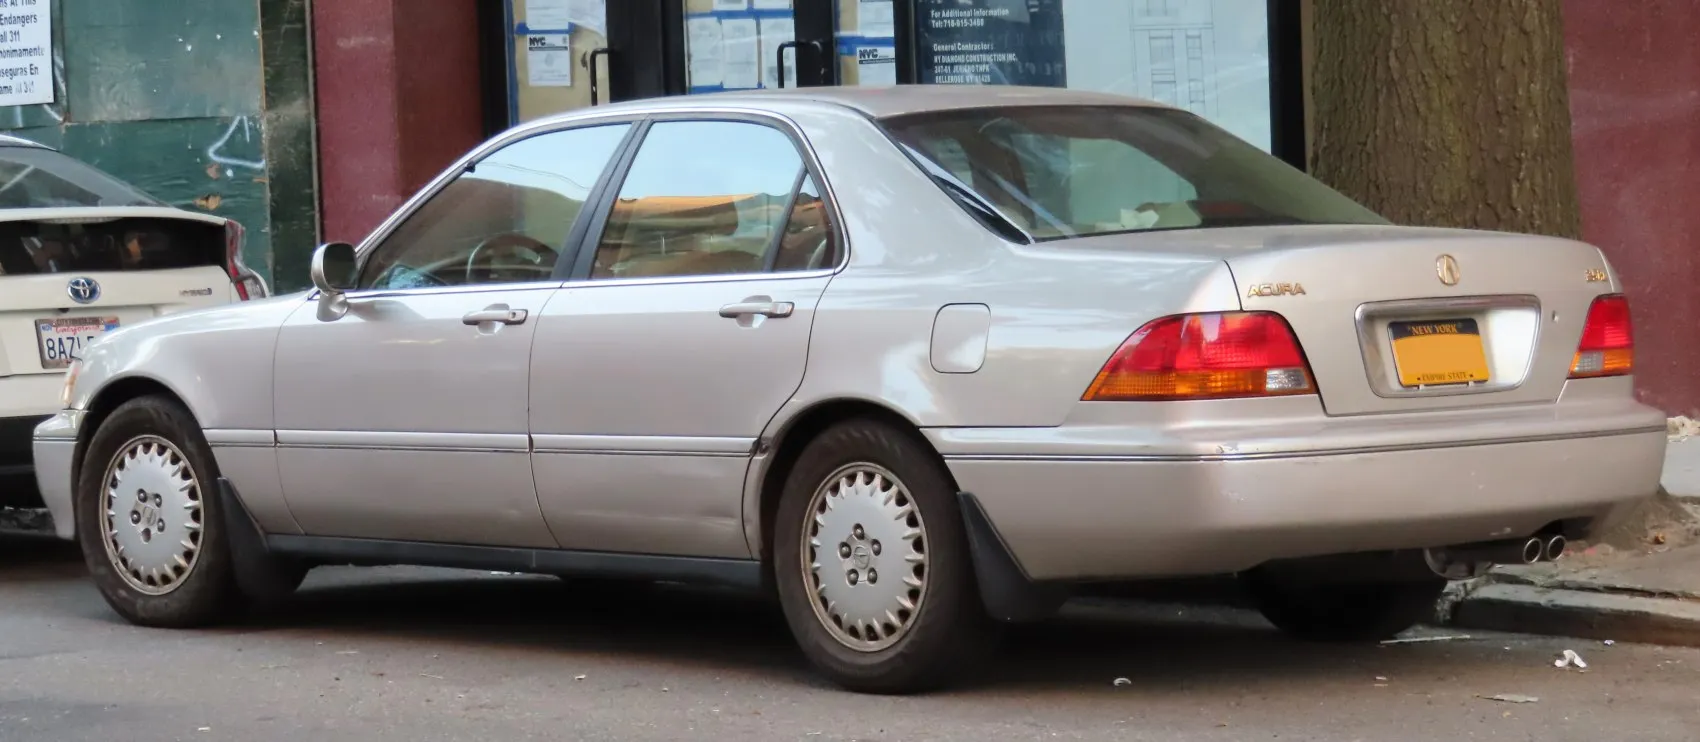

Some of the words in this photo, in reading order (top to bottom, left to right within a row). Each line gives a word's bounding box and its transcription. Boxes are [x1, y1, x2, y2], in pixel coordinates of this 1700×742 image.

[931, 10, 940, 18] For
[942, 9, 972, 18] Additional
[974, 8, 1009, 17] Information
[9, 30, 20, 42] 311
[529, 36, 546, 47] NYC
[933, 43, 956, 51] General
[859, 48, 878, 59] NYC
[966, 53, 1006, 63] CONSTRUCTION
[0, 66, 28, 80] seguras
[30, 63, 39, 75] En
[1248, 283, 1306, 297] ACURA
[1412, 325, 1433, 335] NEW
[1434, 324, 1458, 334] YORK
[46, 336, 94, 360] 8AZ
[1447, 372, 1467, 380] STATE
